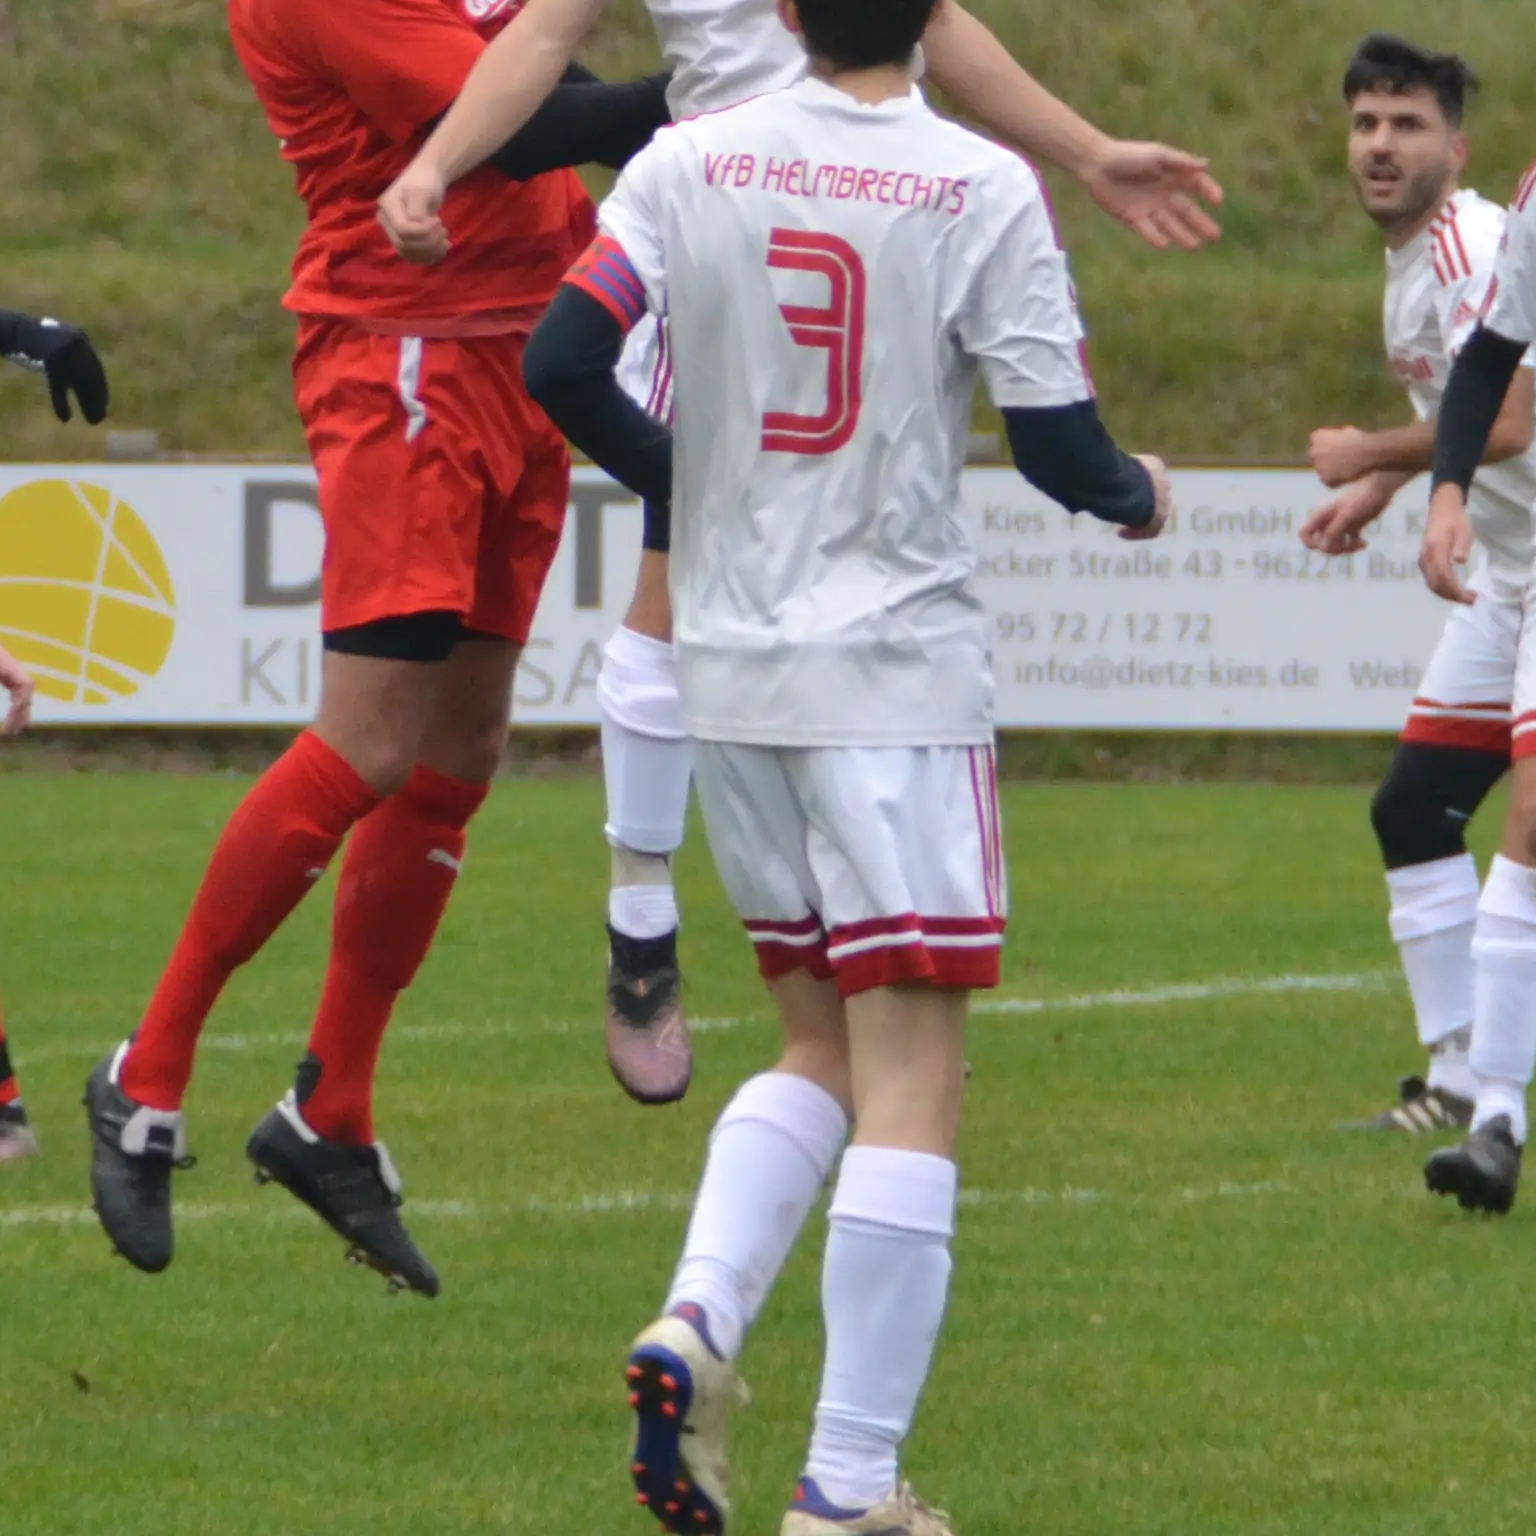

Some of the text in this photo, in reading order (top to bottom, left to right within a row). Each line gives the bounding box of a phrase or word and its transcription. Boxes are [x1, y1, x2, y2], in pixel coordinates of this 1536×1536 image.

[705, 152, 968, 215] VfB HELMBRECHTS
[761, 228, 866, 455] 3
[1190, 505, 1293, 535] GmbH
[1183, 549, 1223, 578] 43
[996, 613, 1035, 643] 95
[1050, 613, 1086, 643] 72
[1125, 613, 1160, 642] 12
[1175, 613, 1212, 642] 72
